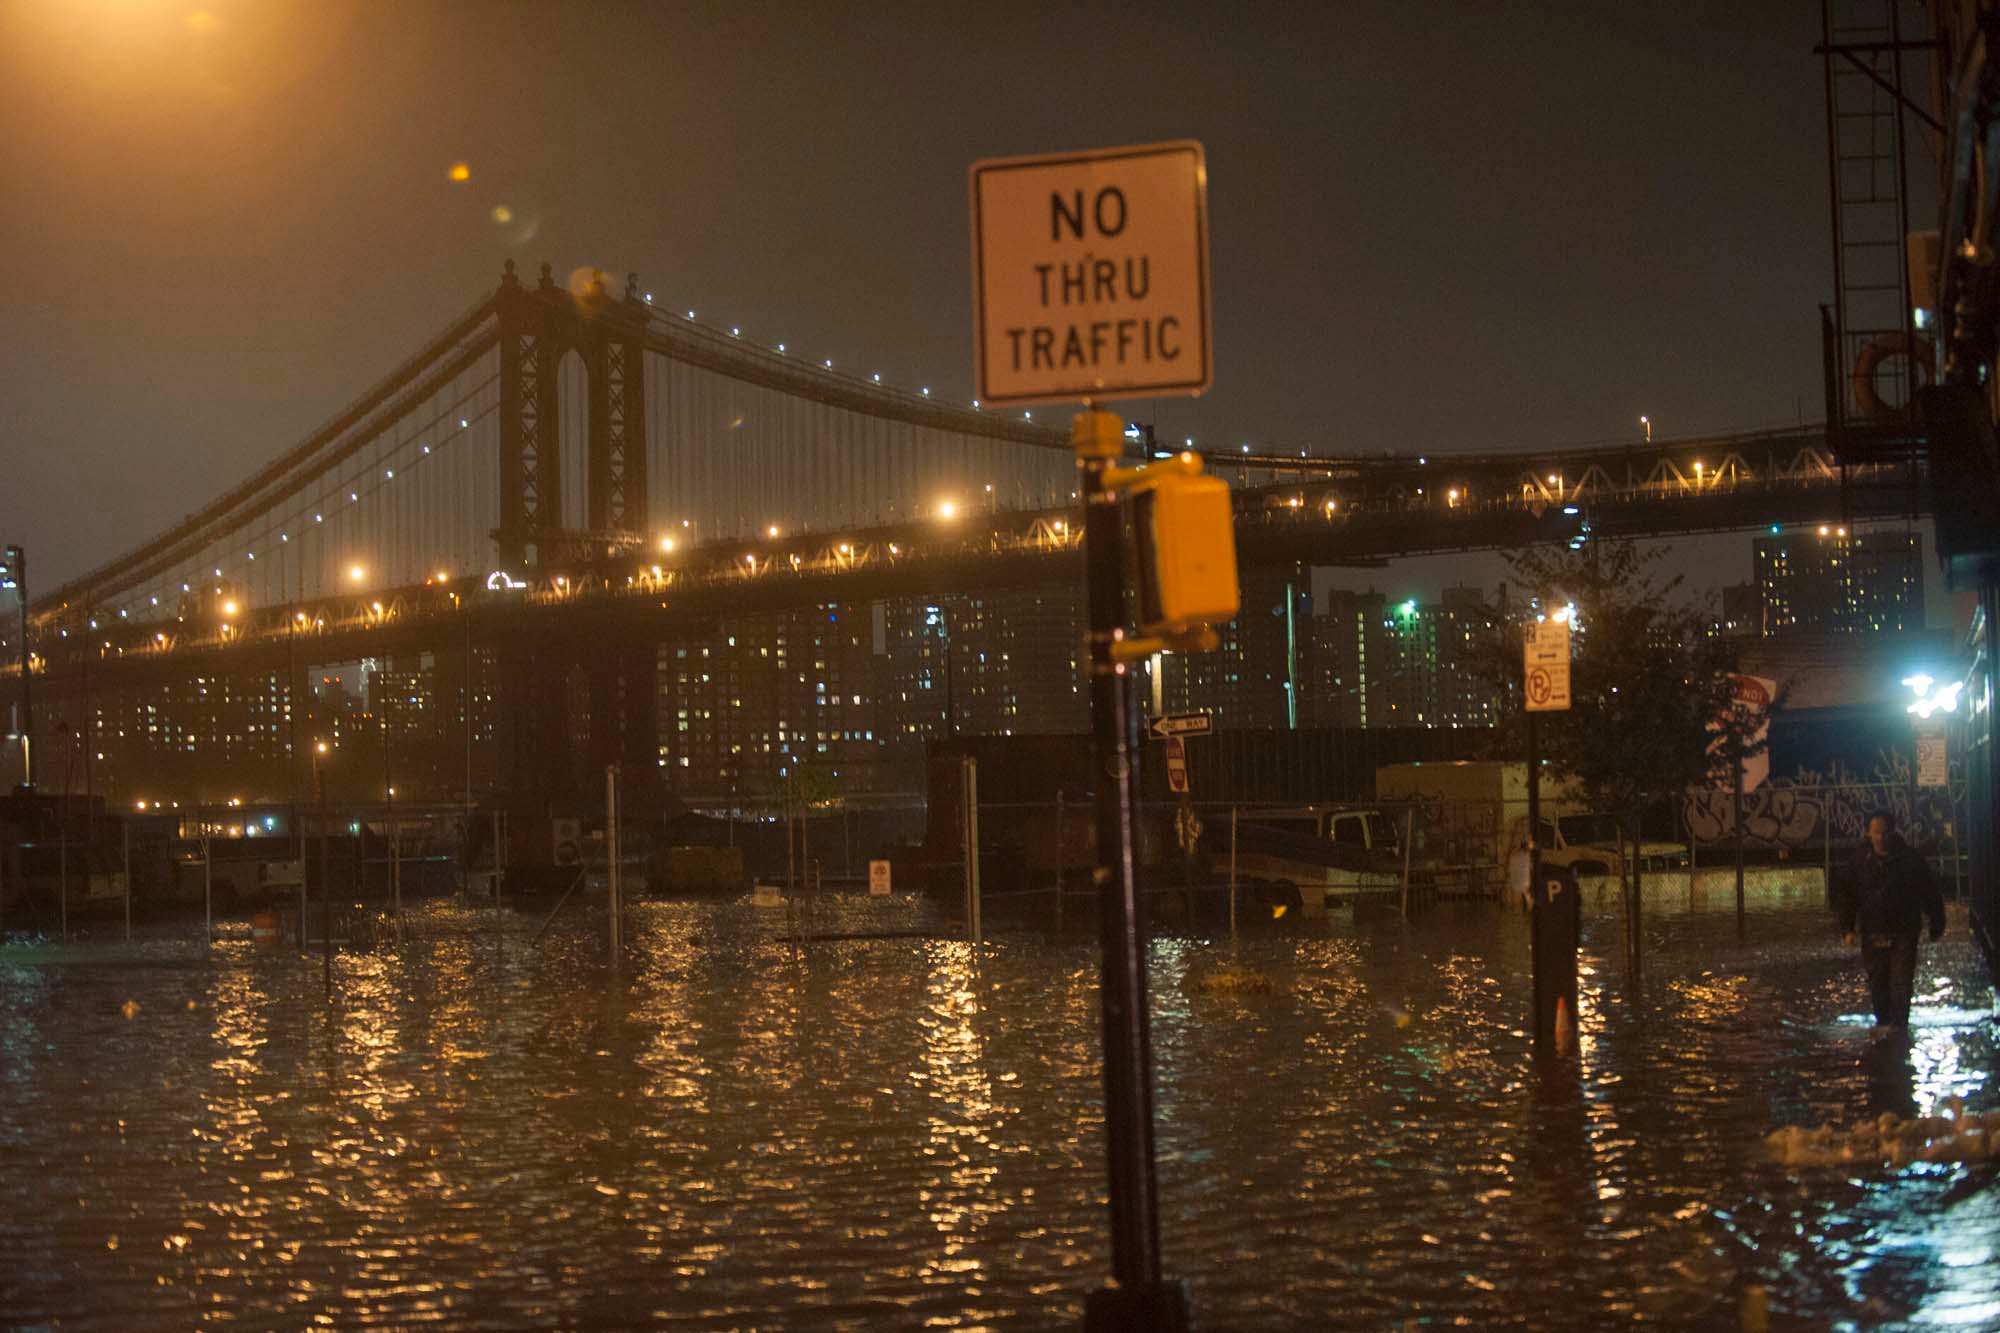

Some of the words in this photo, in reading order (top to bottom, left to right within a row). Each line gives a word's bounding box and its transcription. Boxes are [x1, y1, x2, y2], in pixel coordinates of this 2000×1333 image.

[1050, 184, 1127, 241] NO
[1034, 254, 1150, 307] THRU
[1006, 315, 1181, 372] TRAFFIC
[1186, 718, 1204, 729] WAY
[1547, 879, 1562, 904] P
